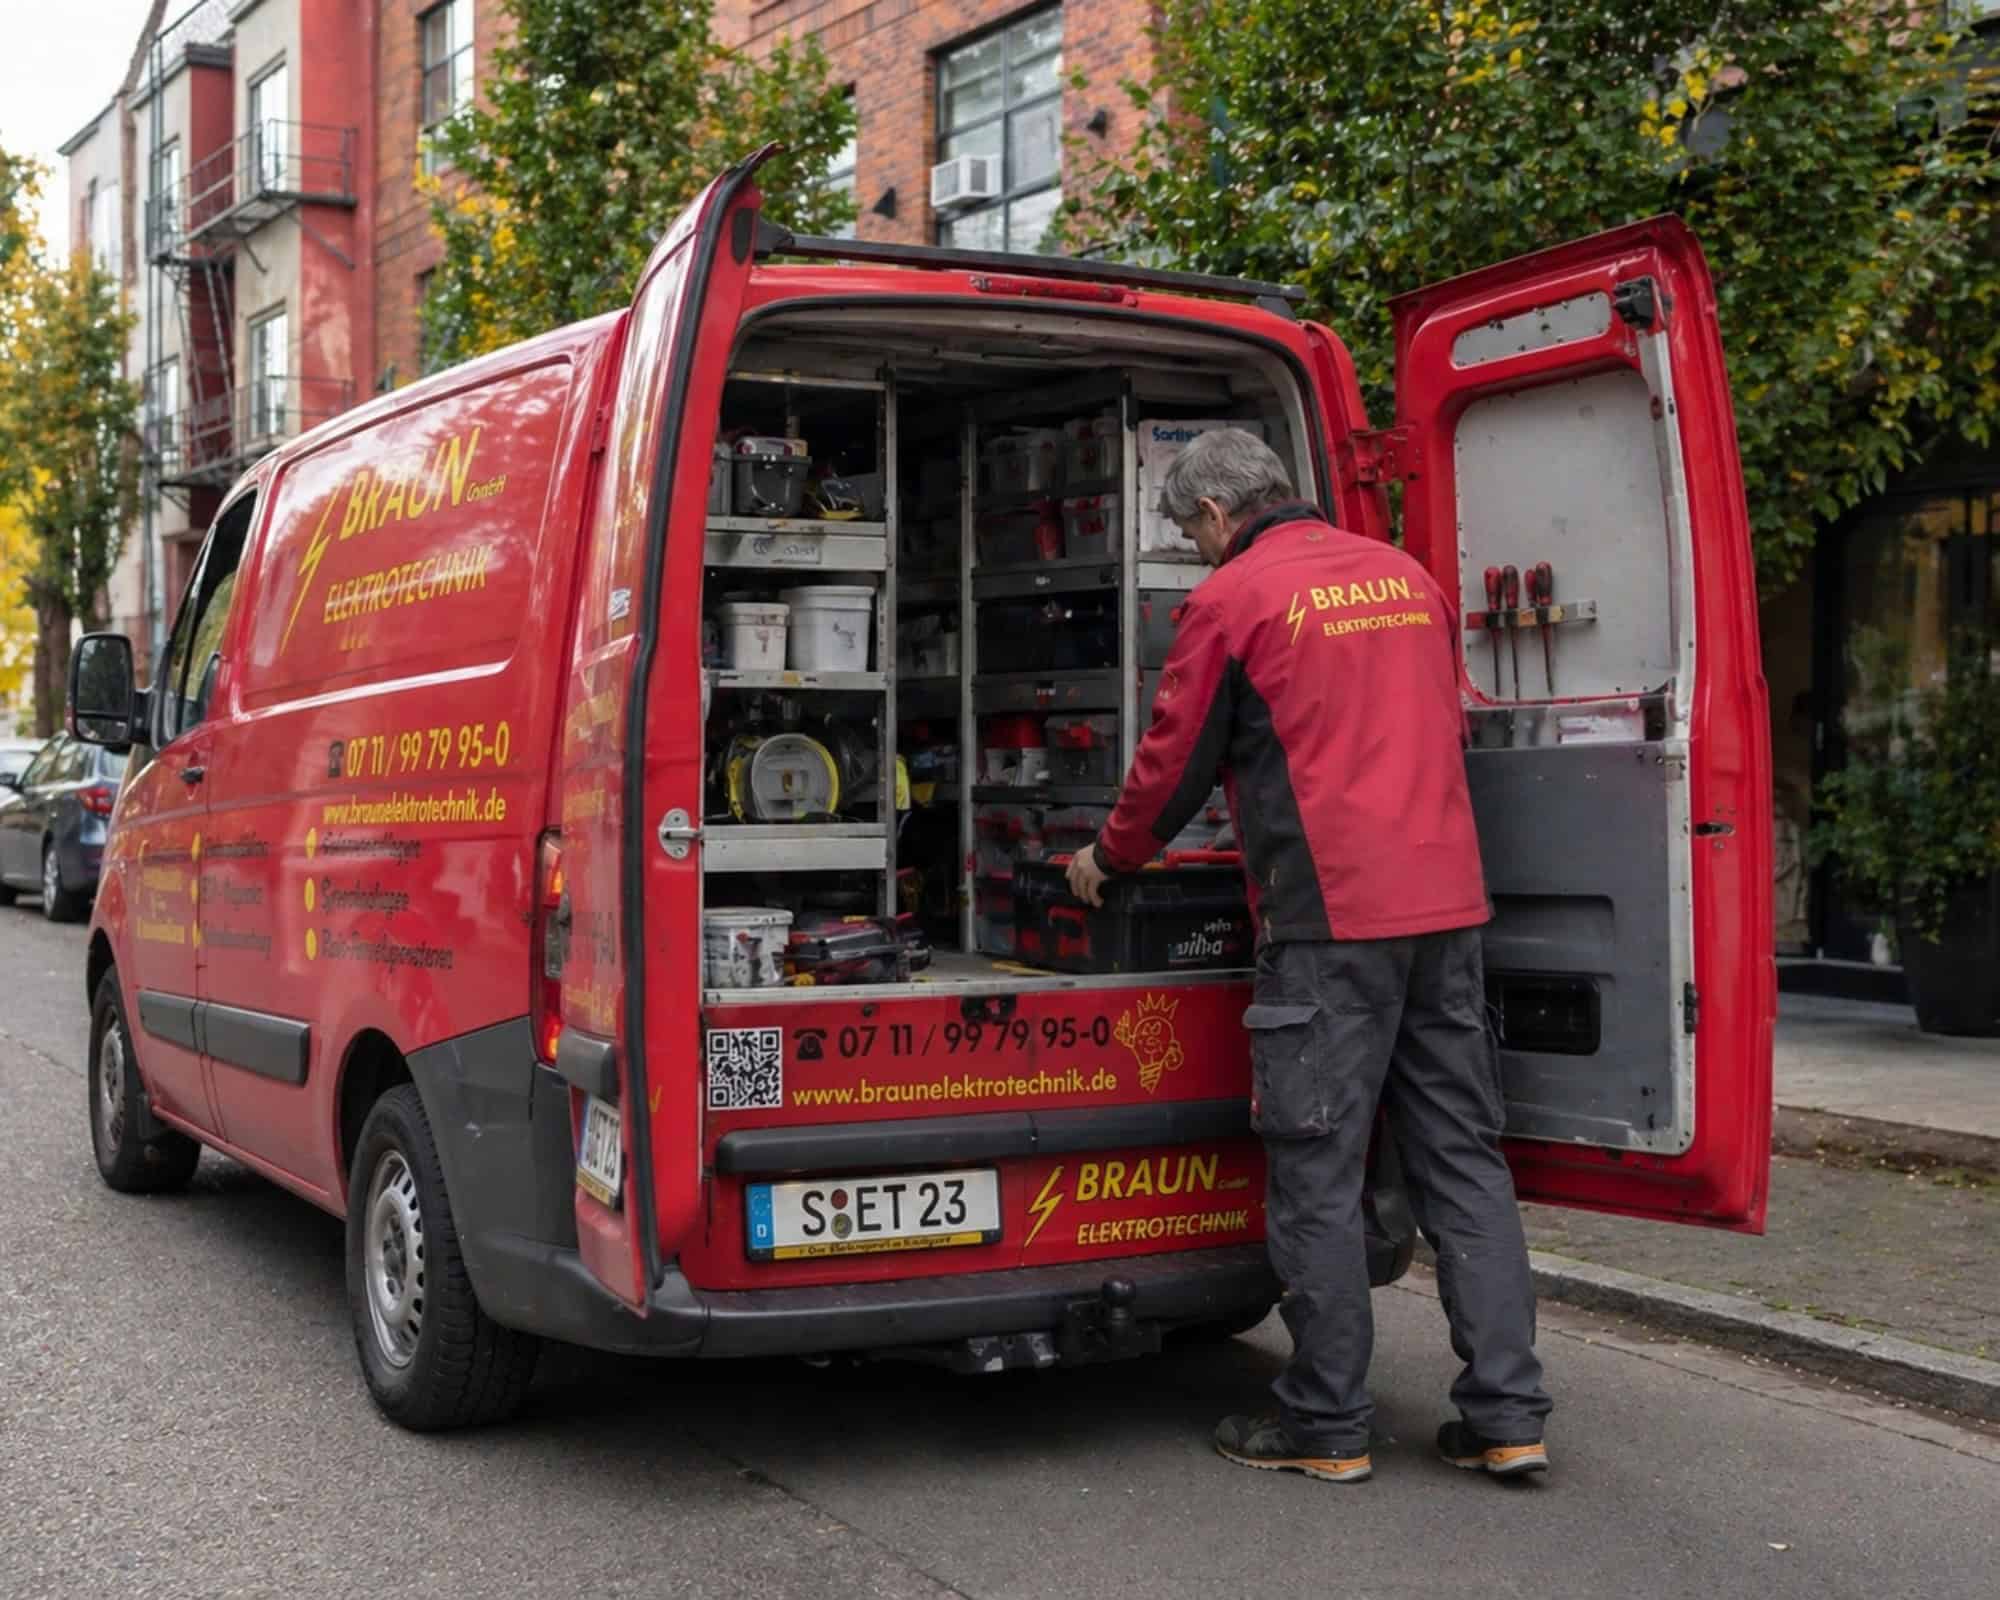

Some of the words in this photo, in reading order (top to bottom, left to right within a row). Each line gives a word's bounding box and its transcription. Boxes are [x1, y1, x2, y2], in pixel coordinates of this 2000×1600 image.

[340, 425, 481, 541] BRAUN
[324, 543, 492, 624] ELEKTROTECHNIK
[1310, 576, 1411, 610] BRAUN
[346, 737, 367, 777] 07
[372, 735, 385, 776] 11
[400, 730, 422, 773] 99
[427, 727, 451, 770] 79
[458, 720, 510, 768] 95-0
[839, 1024, 878, 1059] 07
[891, 1022, 922, 1056] 11
[944, 1020, 982, 1054] 99
[990, 1018, 1028, 1052] 79
[1041, 1014, 1108, 1049] 95-0
[792, 1066, 1115, 1106] www.braunelektrotechnik.de
[1076, 1153, 1218, 1201] BRAUN
[801, 1190, 827, 1237] S
[856, 1184, 907, 1233] ET
[918, 1180, 967, 1229] 23
[1076, 1209, 1249, 1245] ELEKTROTECHNIK
